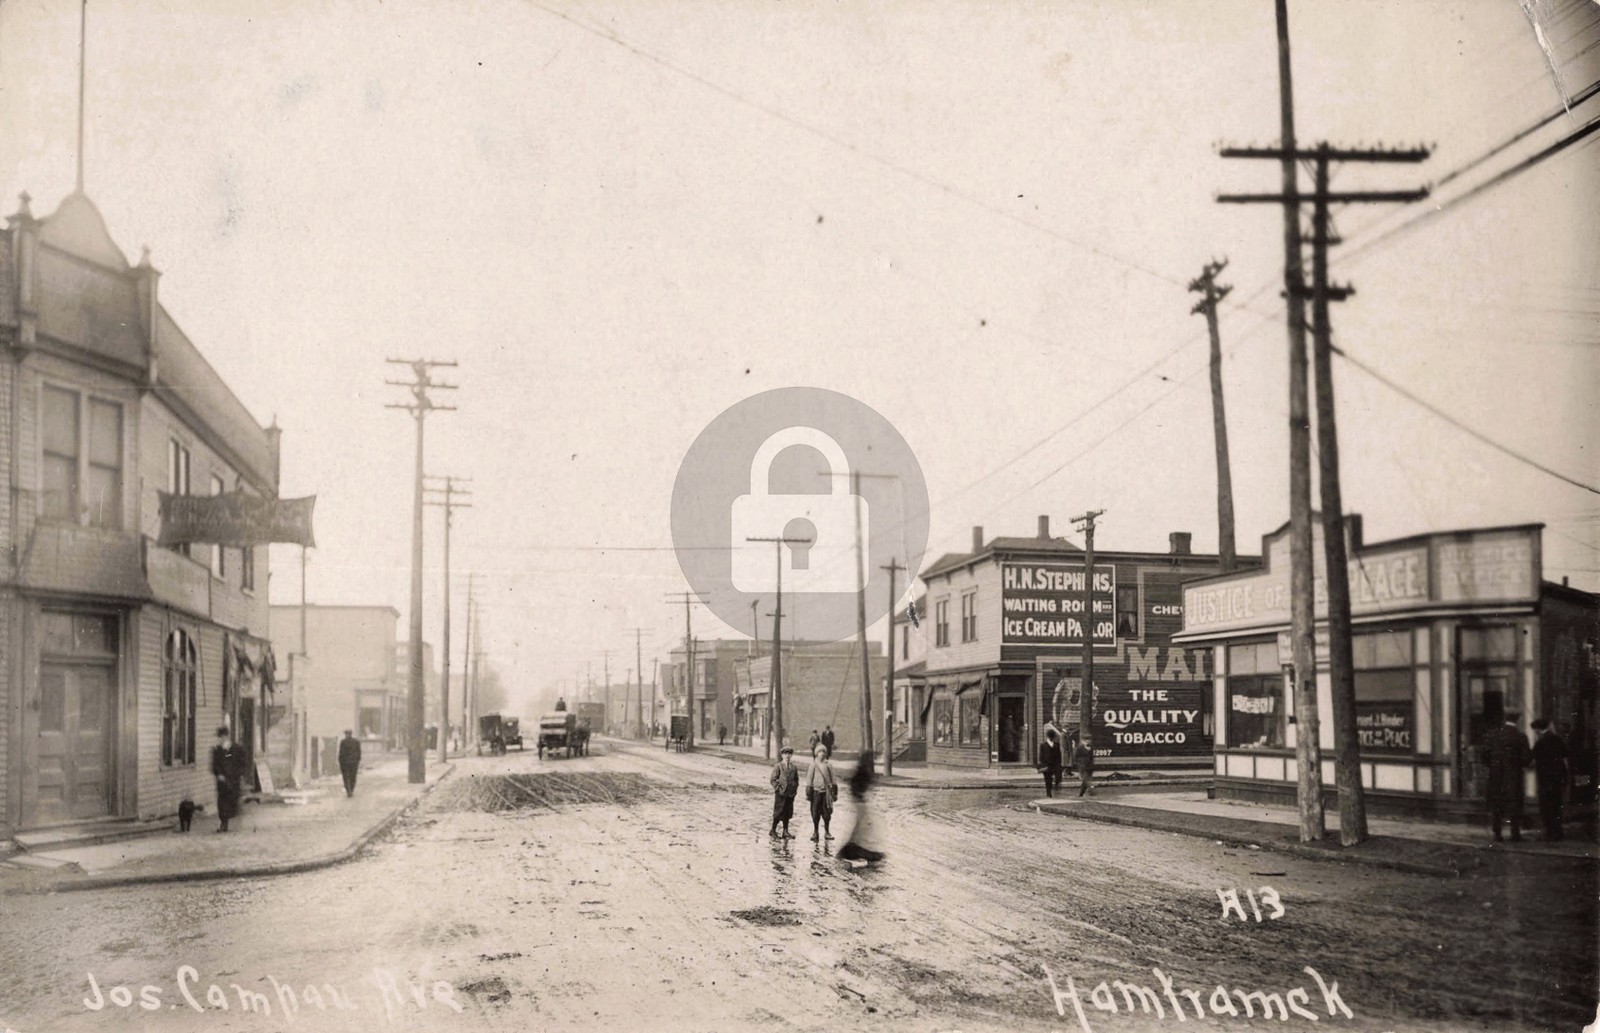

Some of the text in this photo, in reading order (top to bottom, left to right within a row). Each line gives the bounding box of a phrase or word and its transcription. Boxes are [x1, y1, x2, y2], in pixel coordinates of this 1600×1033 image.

[1004, 598, 1057, 612] WAITING
[1152, 605, 1184, 615] CHE
[1186, 585, 1255, 626] JUSTICE
[1264, 583, 1286, 611] OF
[1004, 617, 1113, 638] ICE CREAM PALOR
[1127, 646, 1214, 681] MAI
[1129, 690, 1168, 701] THE
[1103, 709, 1198, 729] QUALITY
[1113, 732, 1186, 744] TOBACCO
